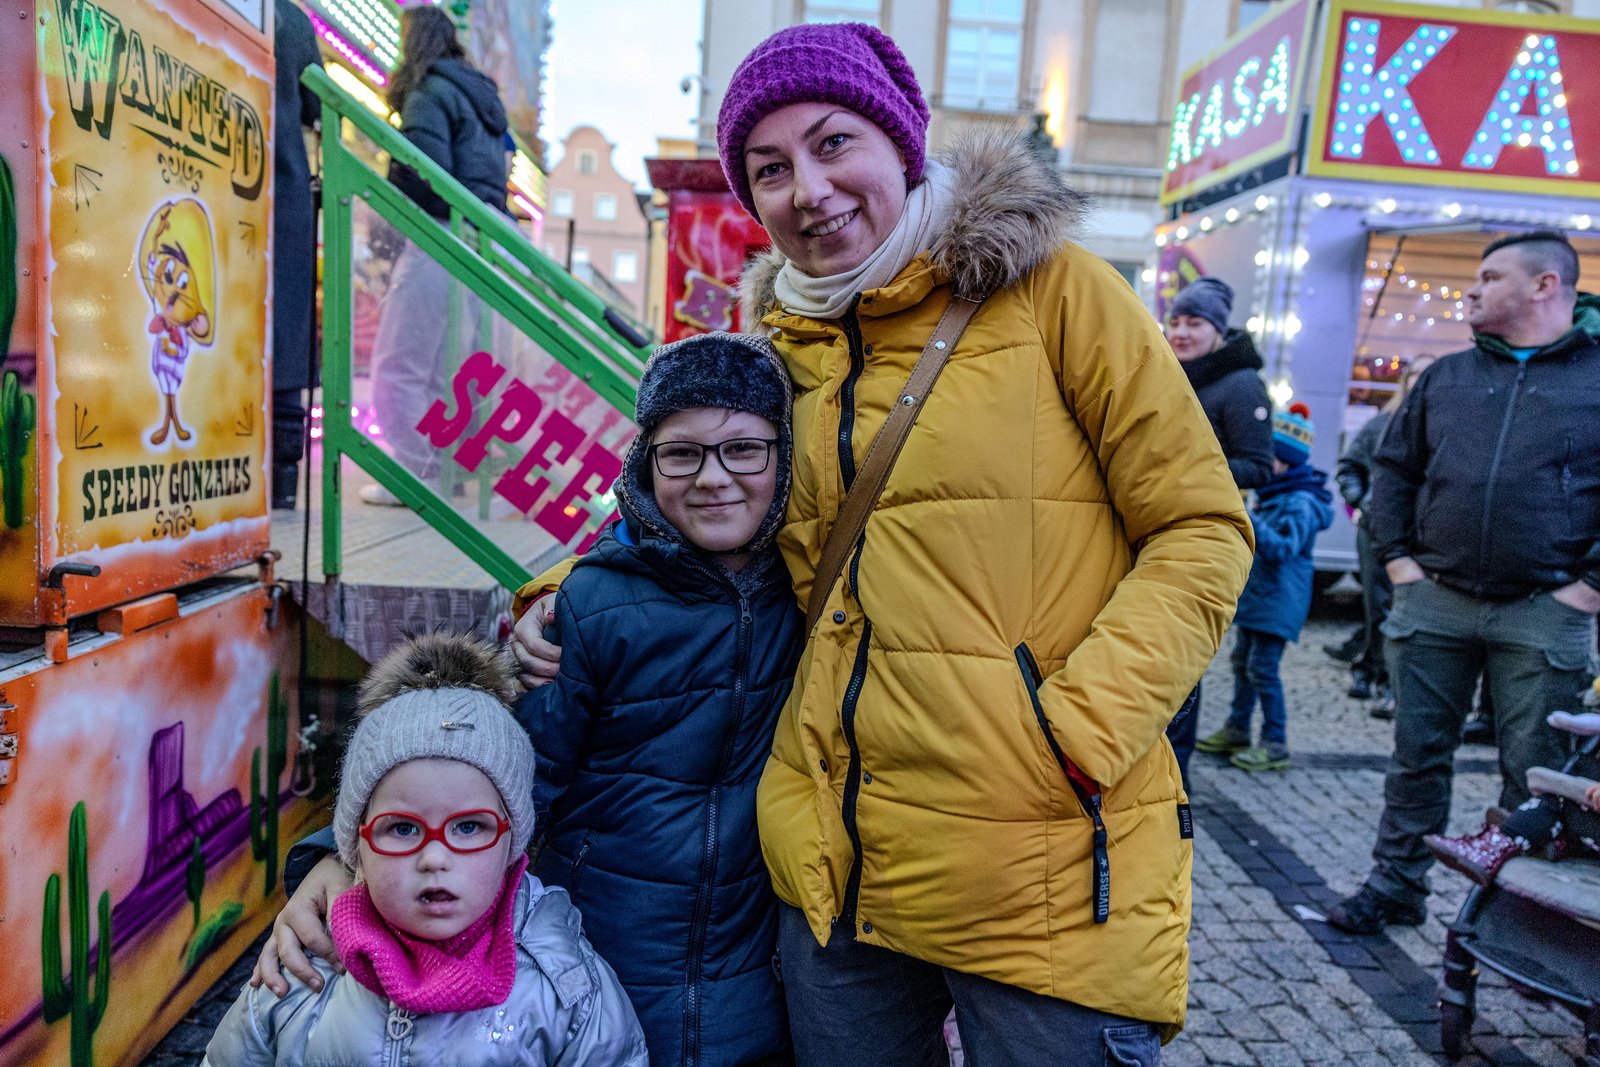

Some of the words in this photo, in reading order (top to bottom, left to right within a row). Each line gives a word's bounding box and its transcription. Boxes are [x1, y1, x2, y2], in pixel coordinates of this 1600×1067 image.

[55, 0, 265, 201] WANTED
[1167, 36, 1290, 172] KASA
[1330, 17, 1580, 176] KA
[82, 464, 164, 522] SPEEDY
[169, 456, 250, 505] GONZALES
[416, 352, 624, 556] SPEE
[1098, 870, 1109, 915] DIVERSE
